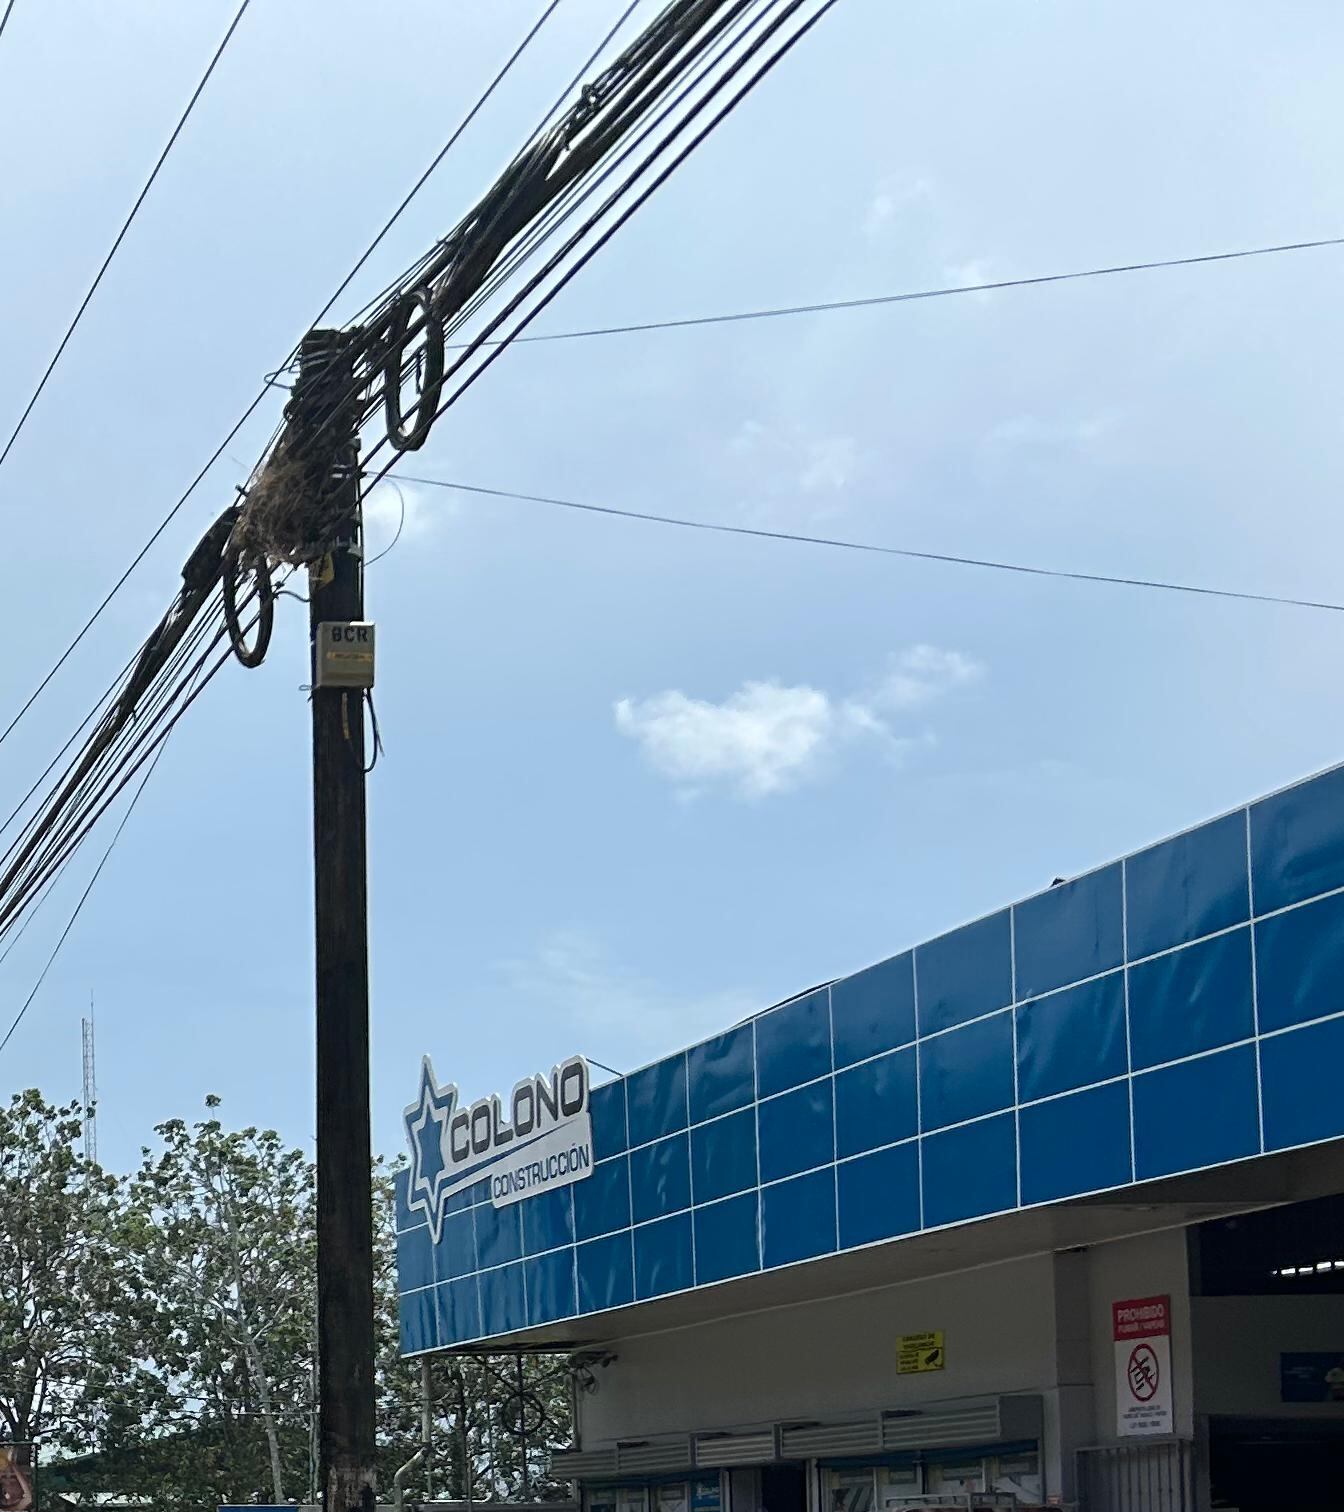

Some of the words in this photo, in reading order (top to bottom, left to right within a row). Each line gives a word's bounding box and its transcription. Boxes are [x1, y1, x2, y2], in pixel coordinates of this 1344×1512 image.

[451, 1061, 585, 1164] COLONO
[493, 1143, 590, 1199] CONSTRUCCIÓN
[1117, 1303, 1164, 1322] PROHIBIDO
